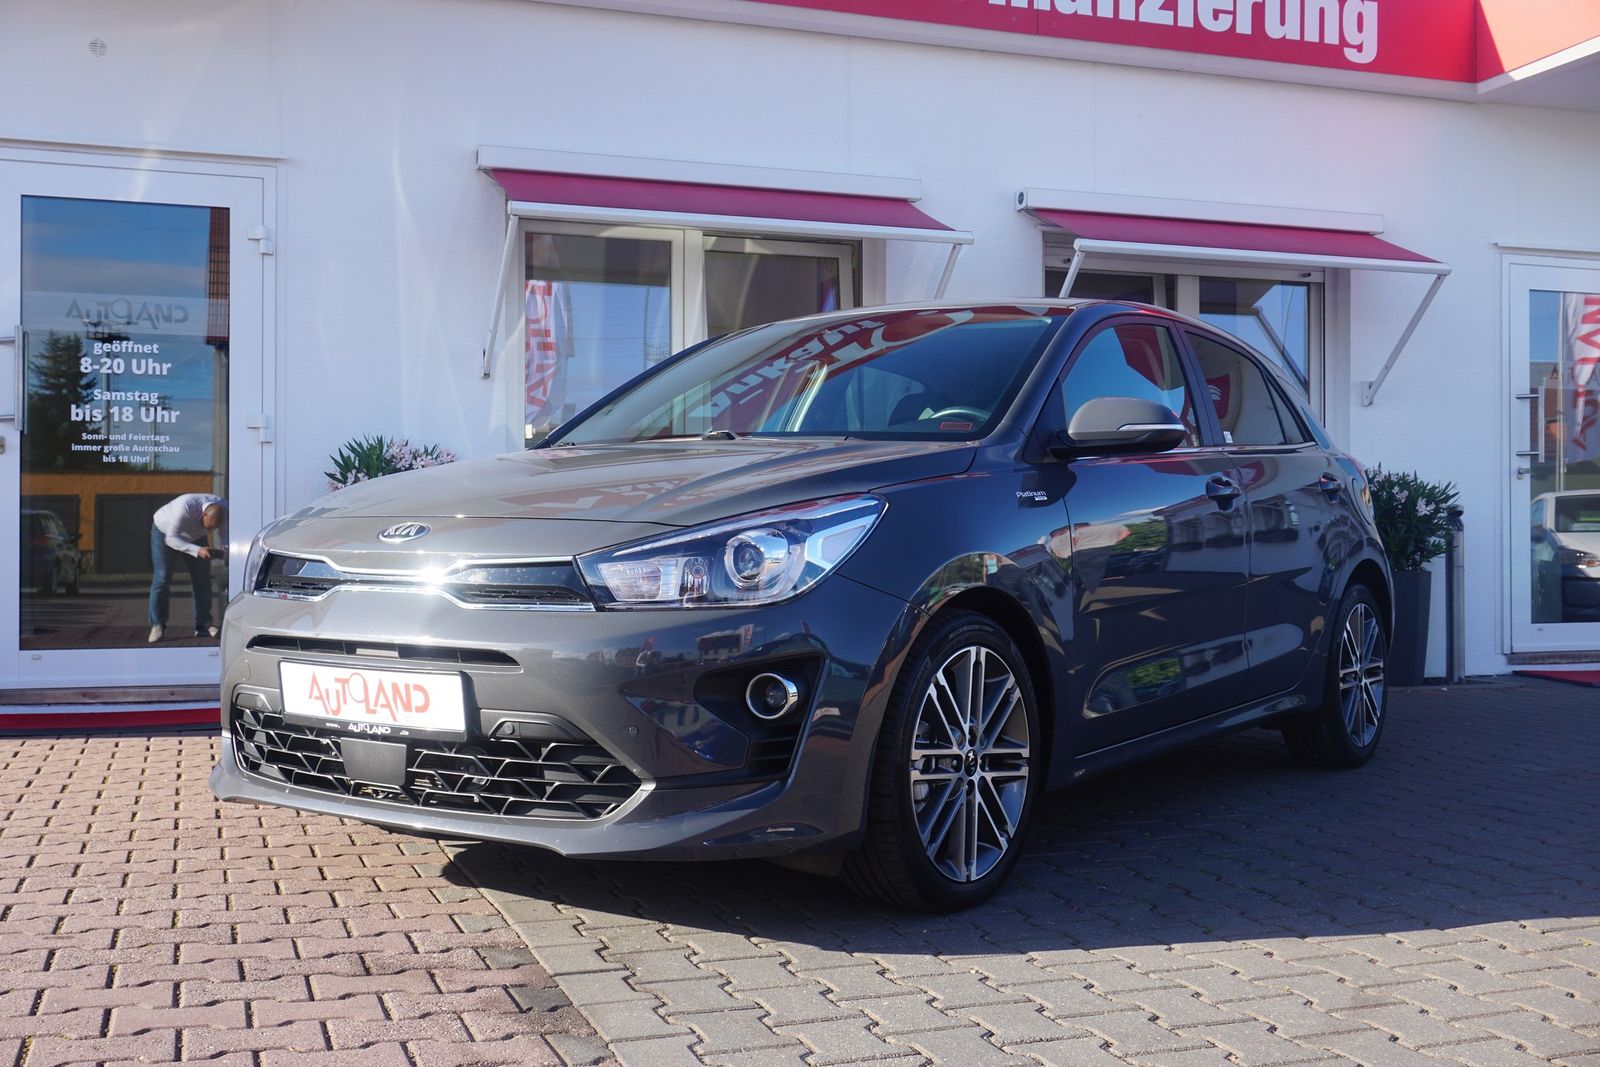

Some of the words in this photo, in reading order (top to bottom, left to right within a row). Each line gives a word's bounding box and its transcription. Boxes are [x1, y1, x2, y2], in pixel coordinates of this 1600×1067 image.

[93, 340, 159, 354] geöffnet
[80, 357, 125, 374] 8-20
[131, 358, 172, 375] Uhr
[93, 389, 159, 404] Samstag
[70, 404, 103, 422] bis
[109, 406, 134, 422] 18
[140, 406, 180, 423] Uhr
[81, 432, 107, 440] Sonn-
[109, 433, 127, 441] und
[128, 433, 170, 443] Feiertags
[103, 443, 130, 453] große
[132, 444, 180, 453] Autoschau
[102, 455, 116, 463] bis
[118, 455, 129, 463] 18
